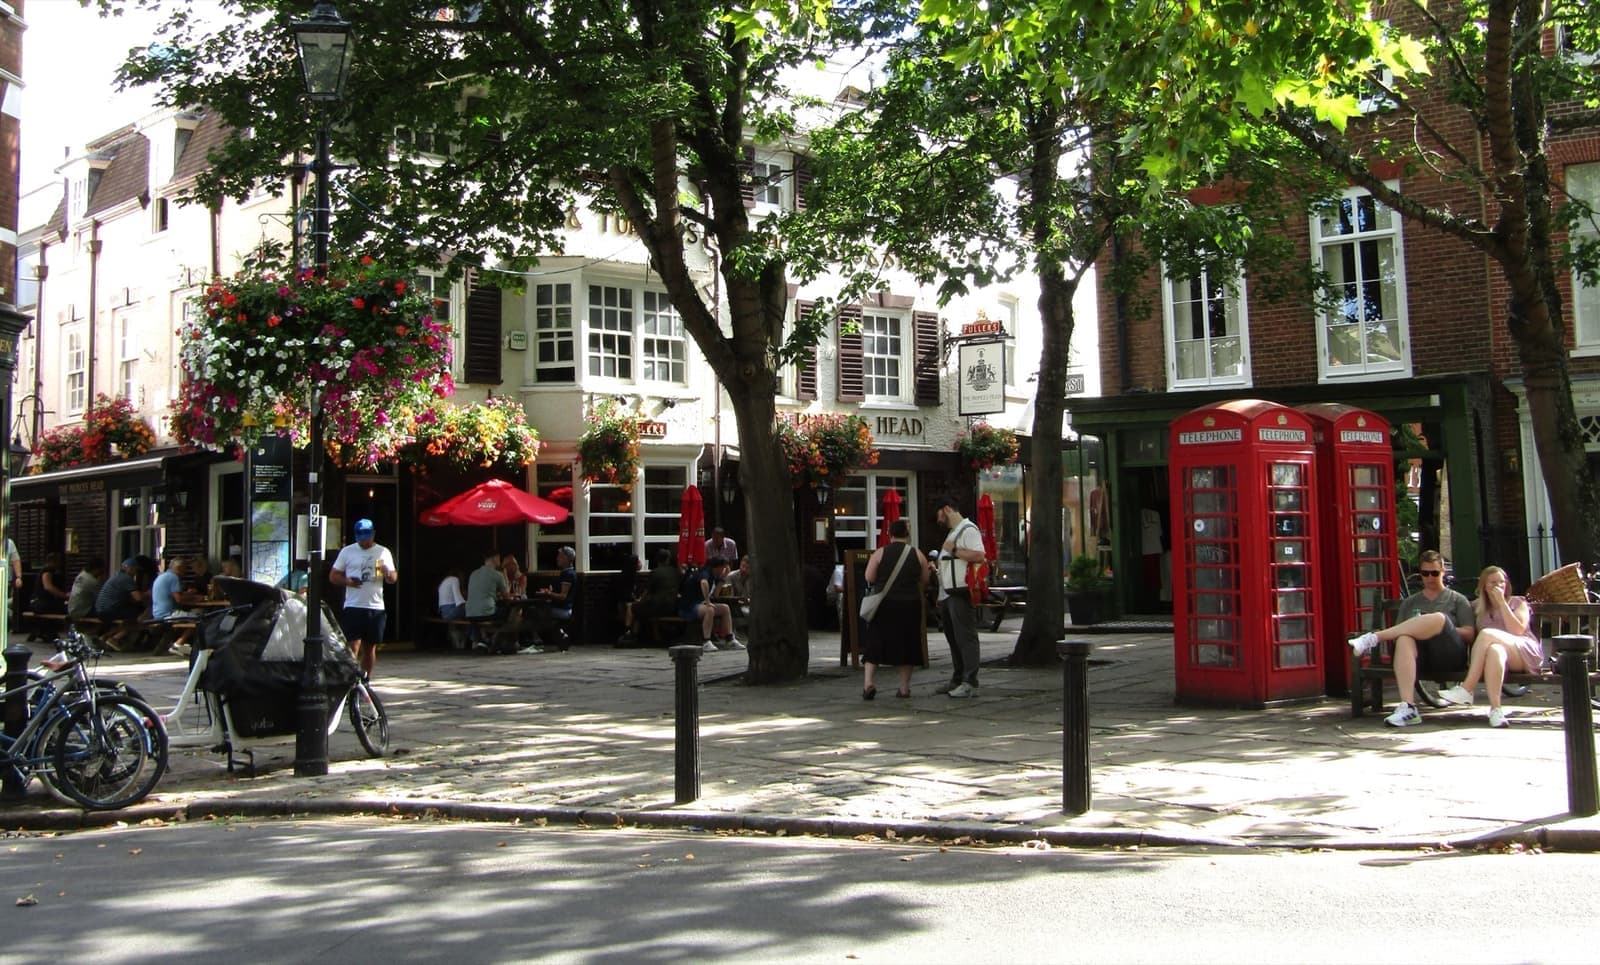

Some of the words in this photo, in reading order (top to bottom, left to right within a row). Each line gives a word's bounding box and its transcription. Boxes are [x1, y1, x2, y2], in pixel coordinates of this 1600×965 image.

[876, 416, 923, 436] HEAD
[1182, 430, 1241, 443] TELEPHONE
[1261, 429, 1305, 441] TELEPHONE
[1342, 431, 1382, 442] TELEPHONE
